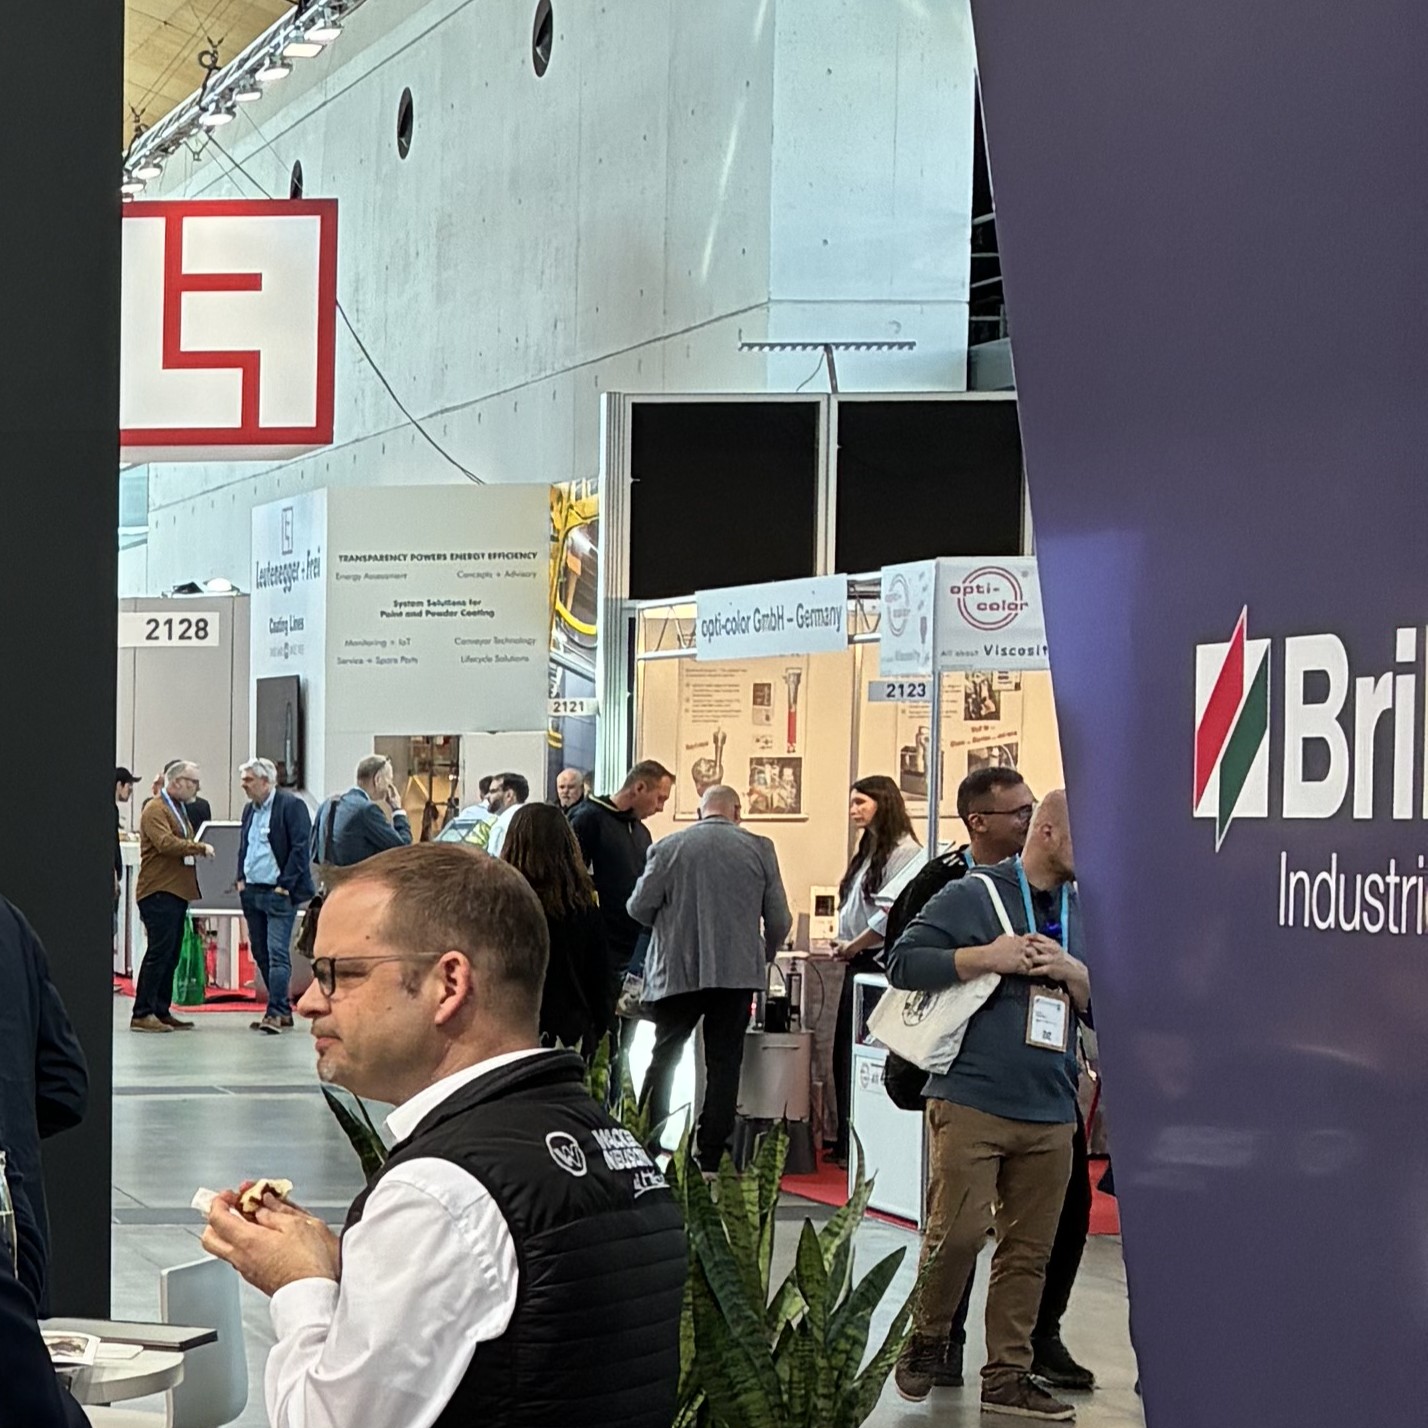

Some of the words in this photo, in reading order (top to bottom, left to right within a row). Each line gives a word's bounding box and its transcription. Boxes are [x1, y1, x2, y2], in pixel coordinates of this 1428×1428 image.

[338, 553, 408, 563] TRANSPARENCY
[410, 552, 448, 562] POWERS
[450, 552, 486, 561] ENERGY
[488, 551, 538, 561] EFFICIENCY
[949, 582, 1000, 597] opti-
[393, 599, 424, 609] System
[426, 598, 467, 608] Solutions
[976, 600, 1029, 612] color
[405, 609, 423, 618] and
[425, 609, 458, 618] Powder
[460, 608, 495, 619] Coating
[145, 617, 209, 641] 2128
[701, 609, 751, 643] opti-color
[753, 604, 785, 633] GmbH
[796, 602, 843, 633] Germany
[886, 682, 927, 699] 2123
[553, 701, 584, 713] 2121
[1282, 622, 1428, 820] Bri
[1279, 851, 1428, 935] Industri
